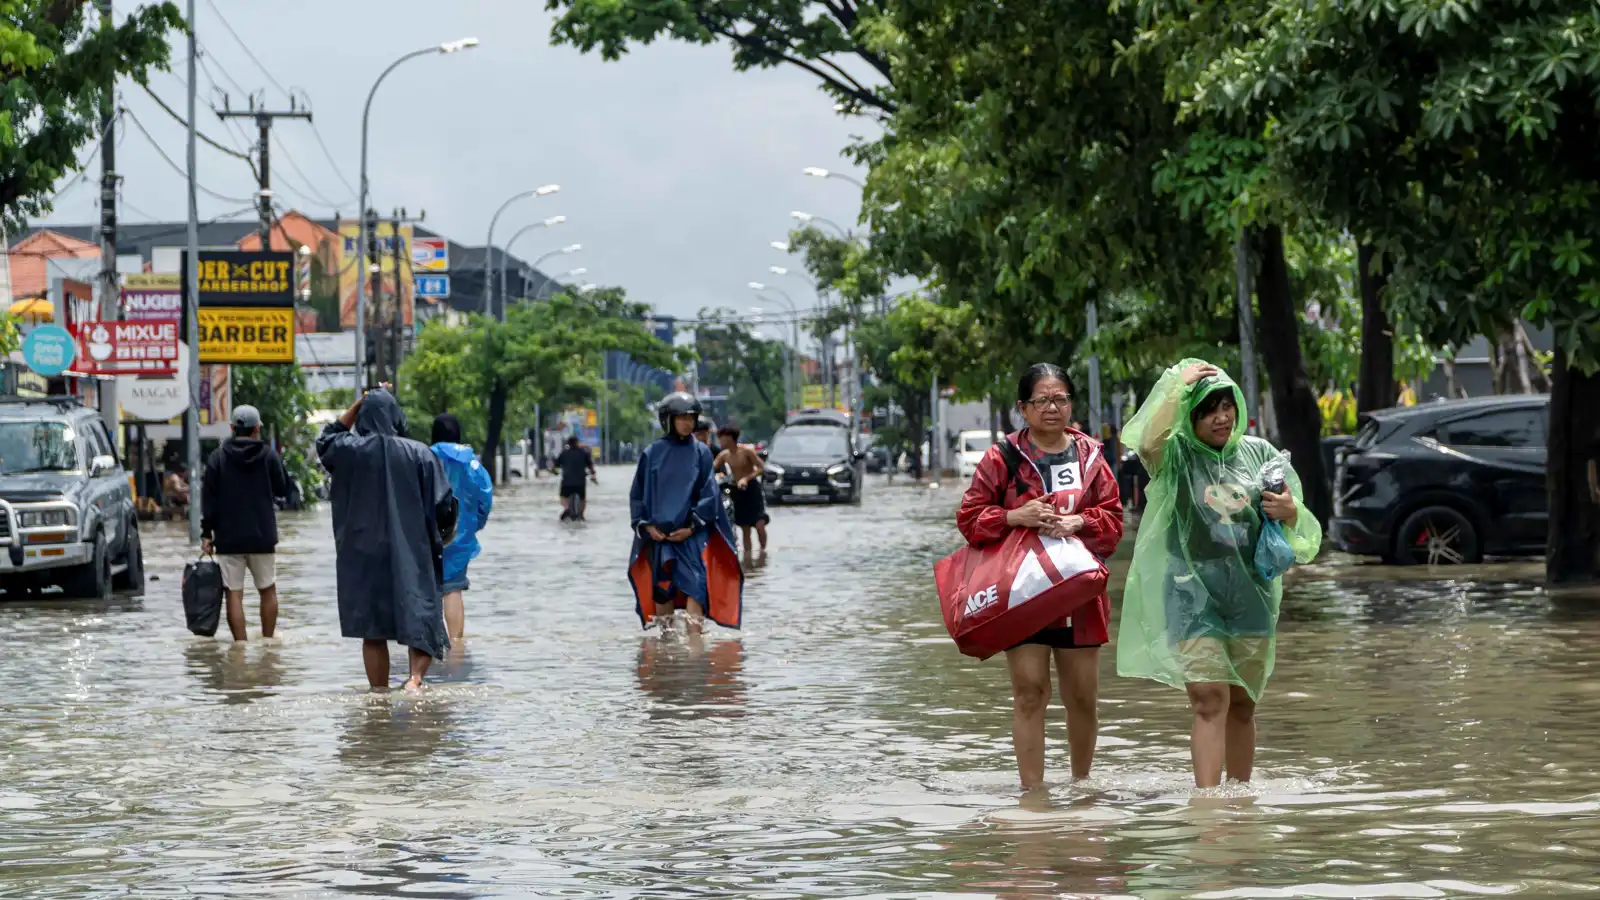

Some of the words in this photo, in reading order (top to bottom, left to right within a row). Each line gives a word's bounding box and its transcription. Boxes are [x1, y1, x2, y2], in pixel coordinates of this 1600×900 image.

[250, 260, 289, 280] CUT
[115, 324, 175, 340] MIXUE
[198, 324, 287, 342] BARBER
[1058, 468, 1074, 485] S
[1059, 494, 1075, 514] J
[964, 584, 999, 615] ACE
